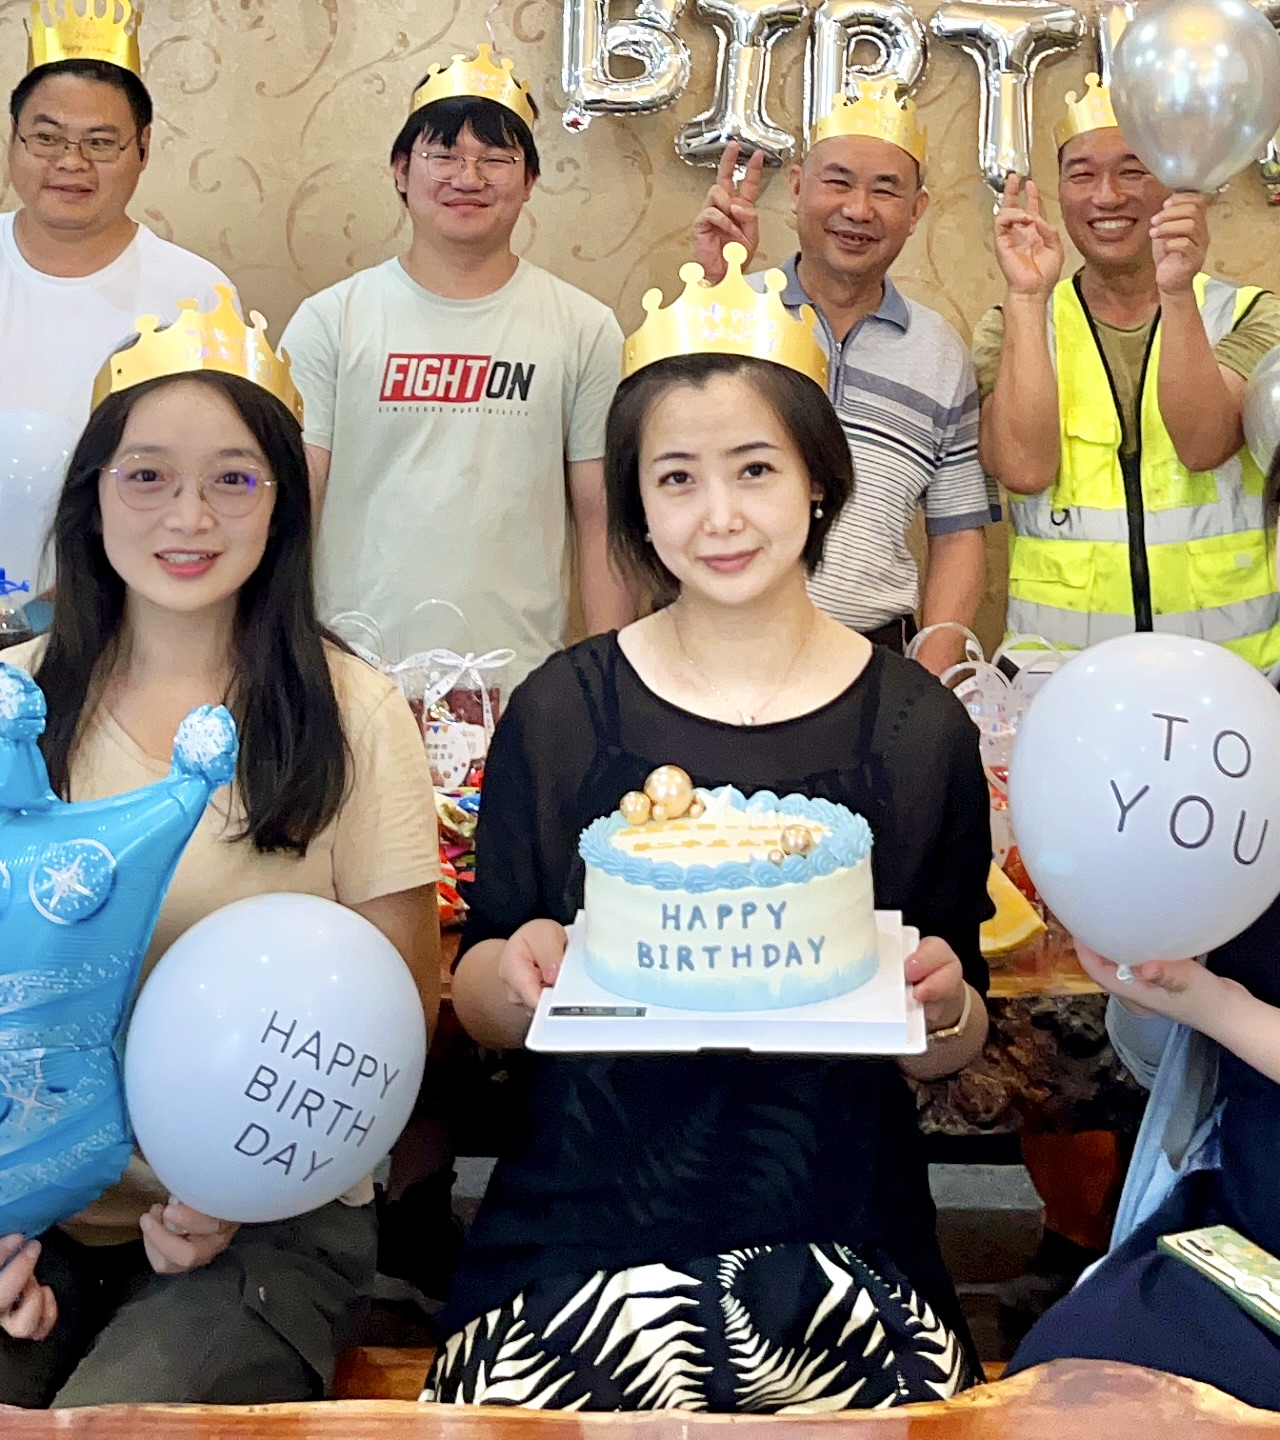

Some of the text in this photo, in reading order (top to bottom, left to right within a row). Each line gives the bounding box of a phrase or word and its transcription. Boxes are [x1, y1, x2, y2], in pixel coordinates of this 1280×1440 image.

[1151, 711, 1253, 779] TO
[1108, 778, 1269, 867] YOU
[660, 900, 789, 931] HAPPY
[636, 936, 826, 973] BIRTHDAY
[261, 1011, 401, 1100] HAPPY
[243, 1064, 378, 1148] BIRTH
[233, 1122, 338, 1184] DAY
